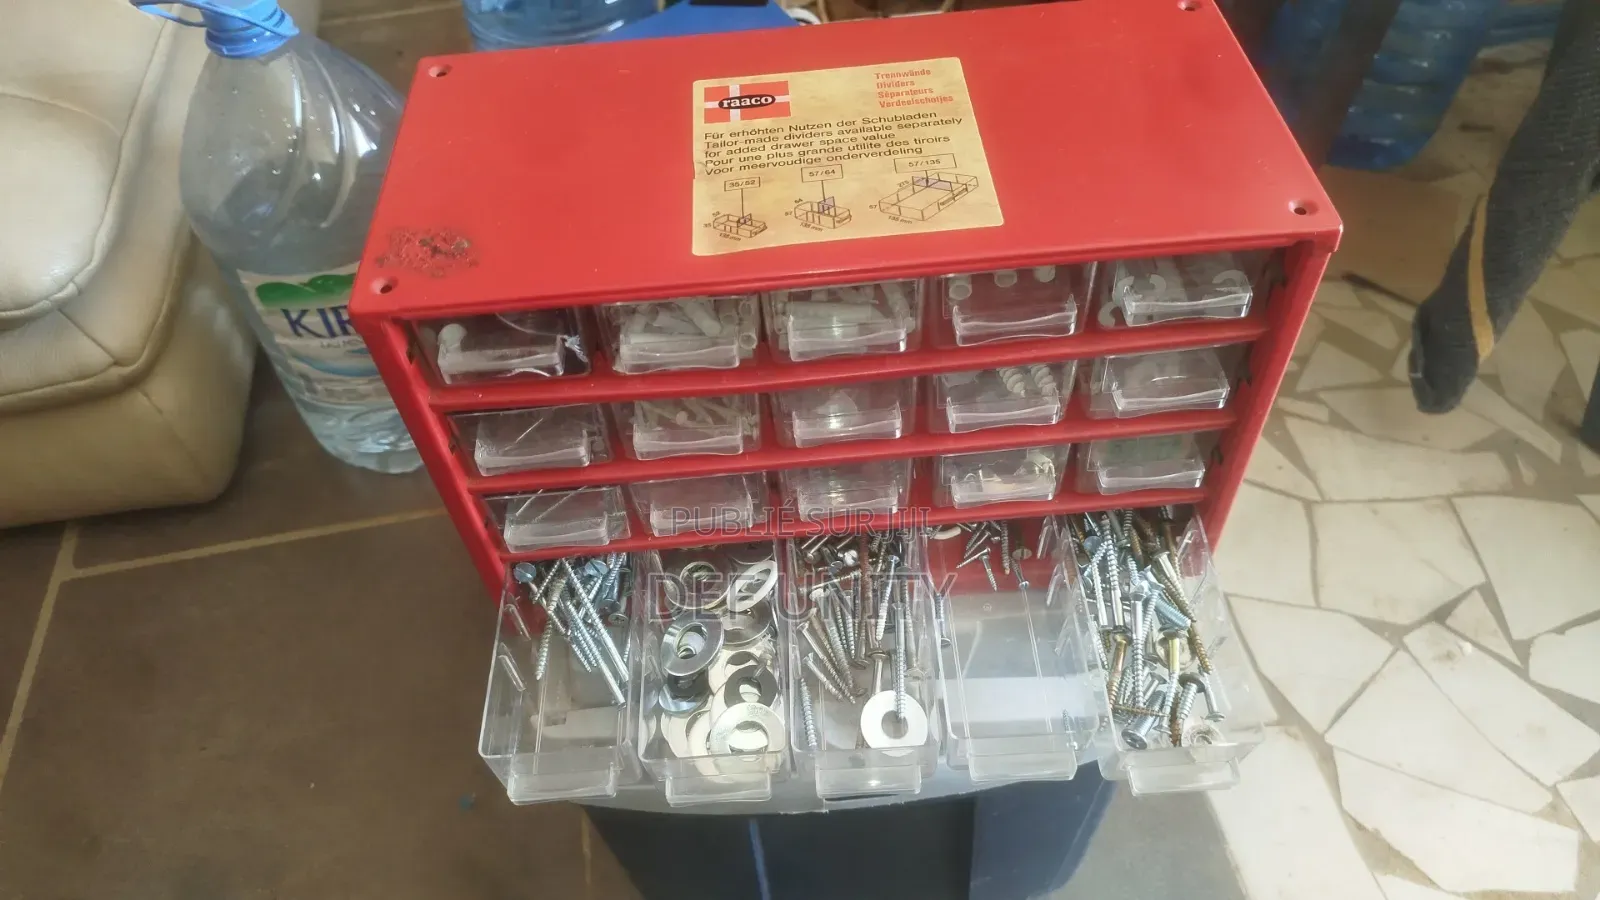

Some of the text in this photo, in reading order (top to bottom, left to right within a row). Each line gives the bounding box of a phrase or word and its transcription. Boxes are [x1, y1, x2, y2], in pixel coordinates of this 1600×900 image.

[875, 68, 931, 80] Trennwände
[876, 80, 915, 89] Dividers
[878, 87, 934, 99] Séparateurs
[722, 95, 773, 108] raaco
[879, 95, 954, 108] Verdeelschotjes
[704, 112, 937, 140] Für erhöhten Nutzen der Schubladen
[704, 117, 962, 149] Tailor-made dividers available separately
[705, 132, 896, 159] for added drawer space value
[705, 158, 737, 168] Pour
[738, 154, 762, 163] une
[766, 149, 794, 161] plus
[798, 145, 843, 157] grande
[886, 137, 910, 148] des
[914, 135, 951, 145] tiroirs
[705, 146, 923, 176] Voor meervoudige onderverdeling
[908, 159, 941, 168] 57/135
[808, 169, 836, 177] 57/64
[729, 180, 756, 188] 35/52
